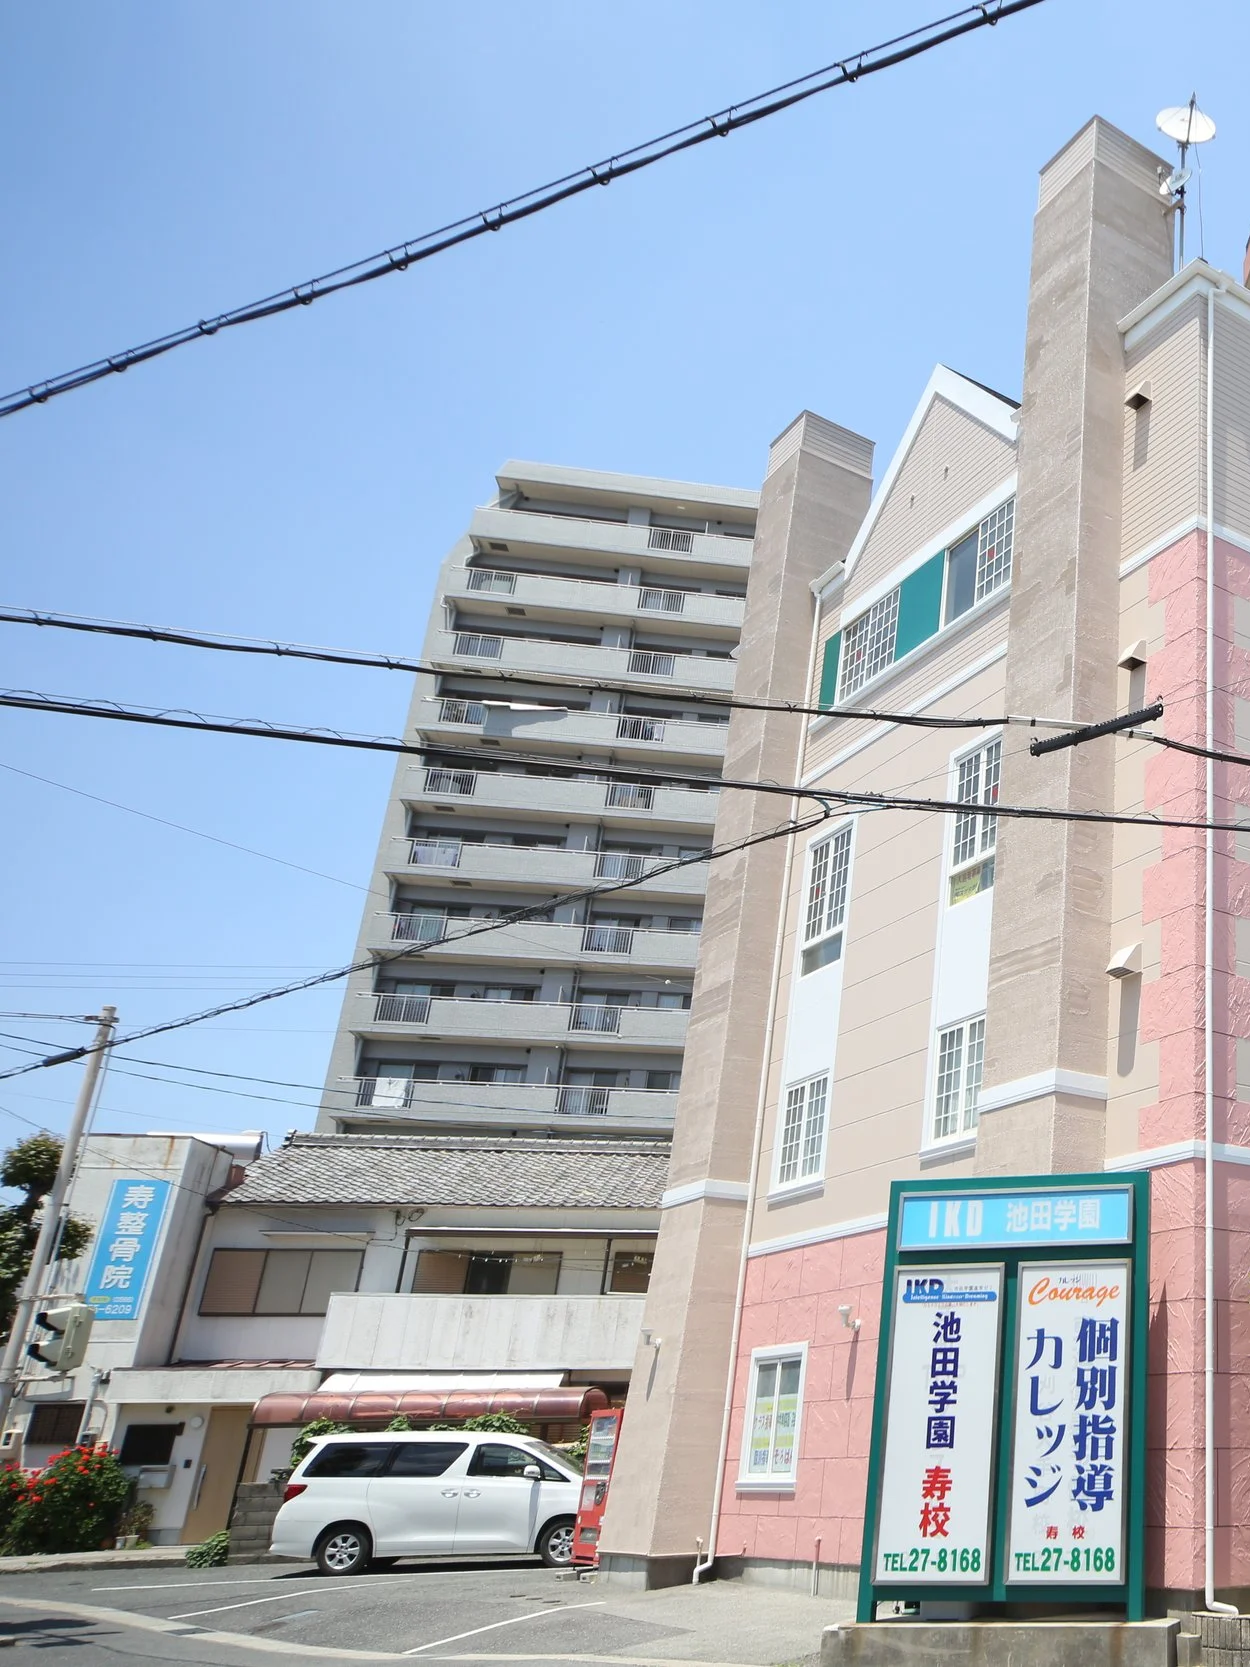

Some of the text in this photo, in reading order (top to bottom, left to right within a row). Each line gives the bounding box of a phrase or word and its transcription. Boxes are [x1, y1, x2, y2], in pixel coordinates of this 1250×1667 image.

[100, 1185, 156, 1289] 寿整骨院
[928, 1200, 983, 1238] IKD
[1006, 1199, 1100, 1232] 池田学園
[906, 1279, 944, 1294] IKD
[1028, 1277, 1120, 1308] Courage
[926, 1311, 962, 1449] 池田学園
[1072, 1317, 1119, 1512] 個別指導
[1024, 1328, 1066, 1508] カレッジ
[919, 1466, 953, 1538] 寿校
